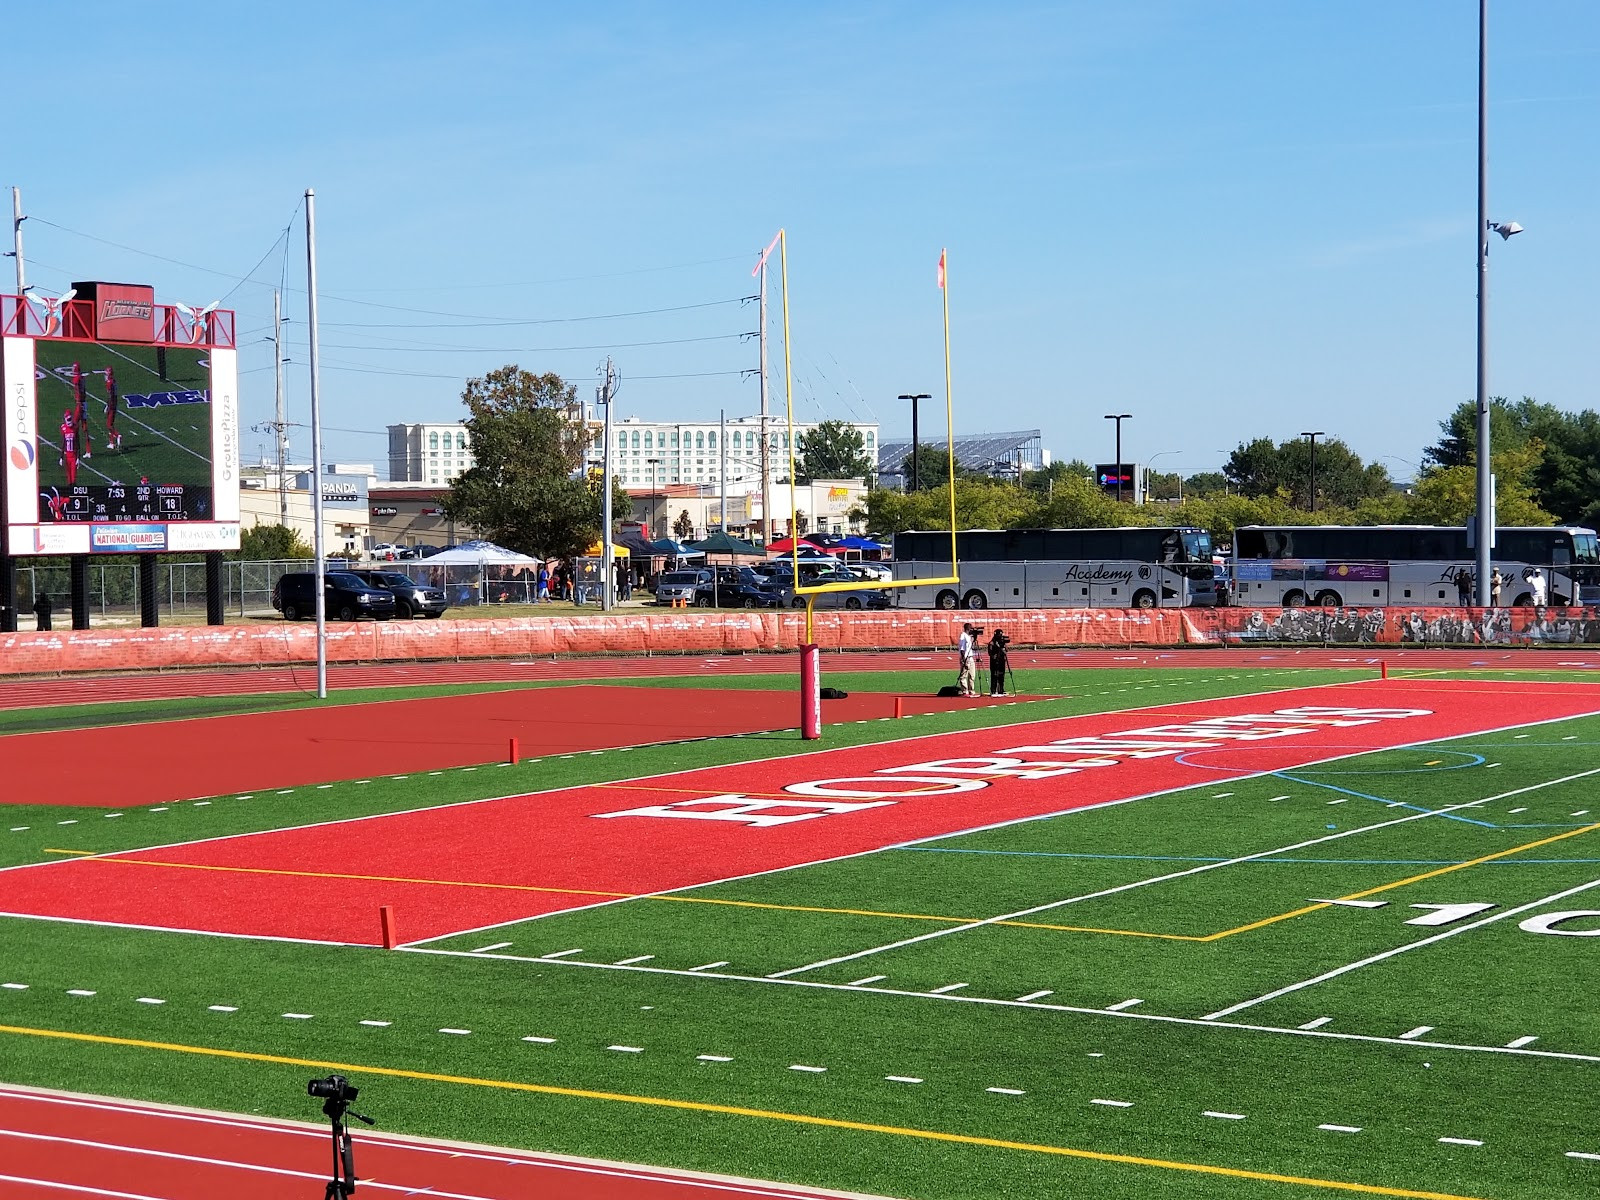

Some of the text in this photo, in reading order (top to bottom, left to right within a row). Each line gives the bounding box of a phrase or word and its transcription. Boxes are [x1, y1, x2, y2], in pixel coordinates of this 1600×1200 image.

[99, 300, 152, 323] HORNETS
[14, 383, 29, 435] pepsi
[221, 394, 231, 481] Grotto Pizza
[107, 488, 125, 498] 7:53
[136, 487, 150, 495] 2ND
[156, 486, 183, 494] HOWARD
[322, 483, 357, 494] PANDA
[74, 499, 81, 509] 9
[120, 504, 126, 513] 4
[142, 504, 151, 513] 41
[165, 499, 176, 509] 18
[96, 534, 129, 544] NATIONAL
[130, 533, 153, 543] GUARD
[1065, 563, 1134, 585] Academy
[588, 704, 1434, 828] HORNETS
